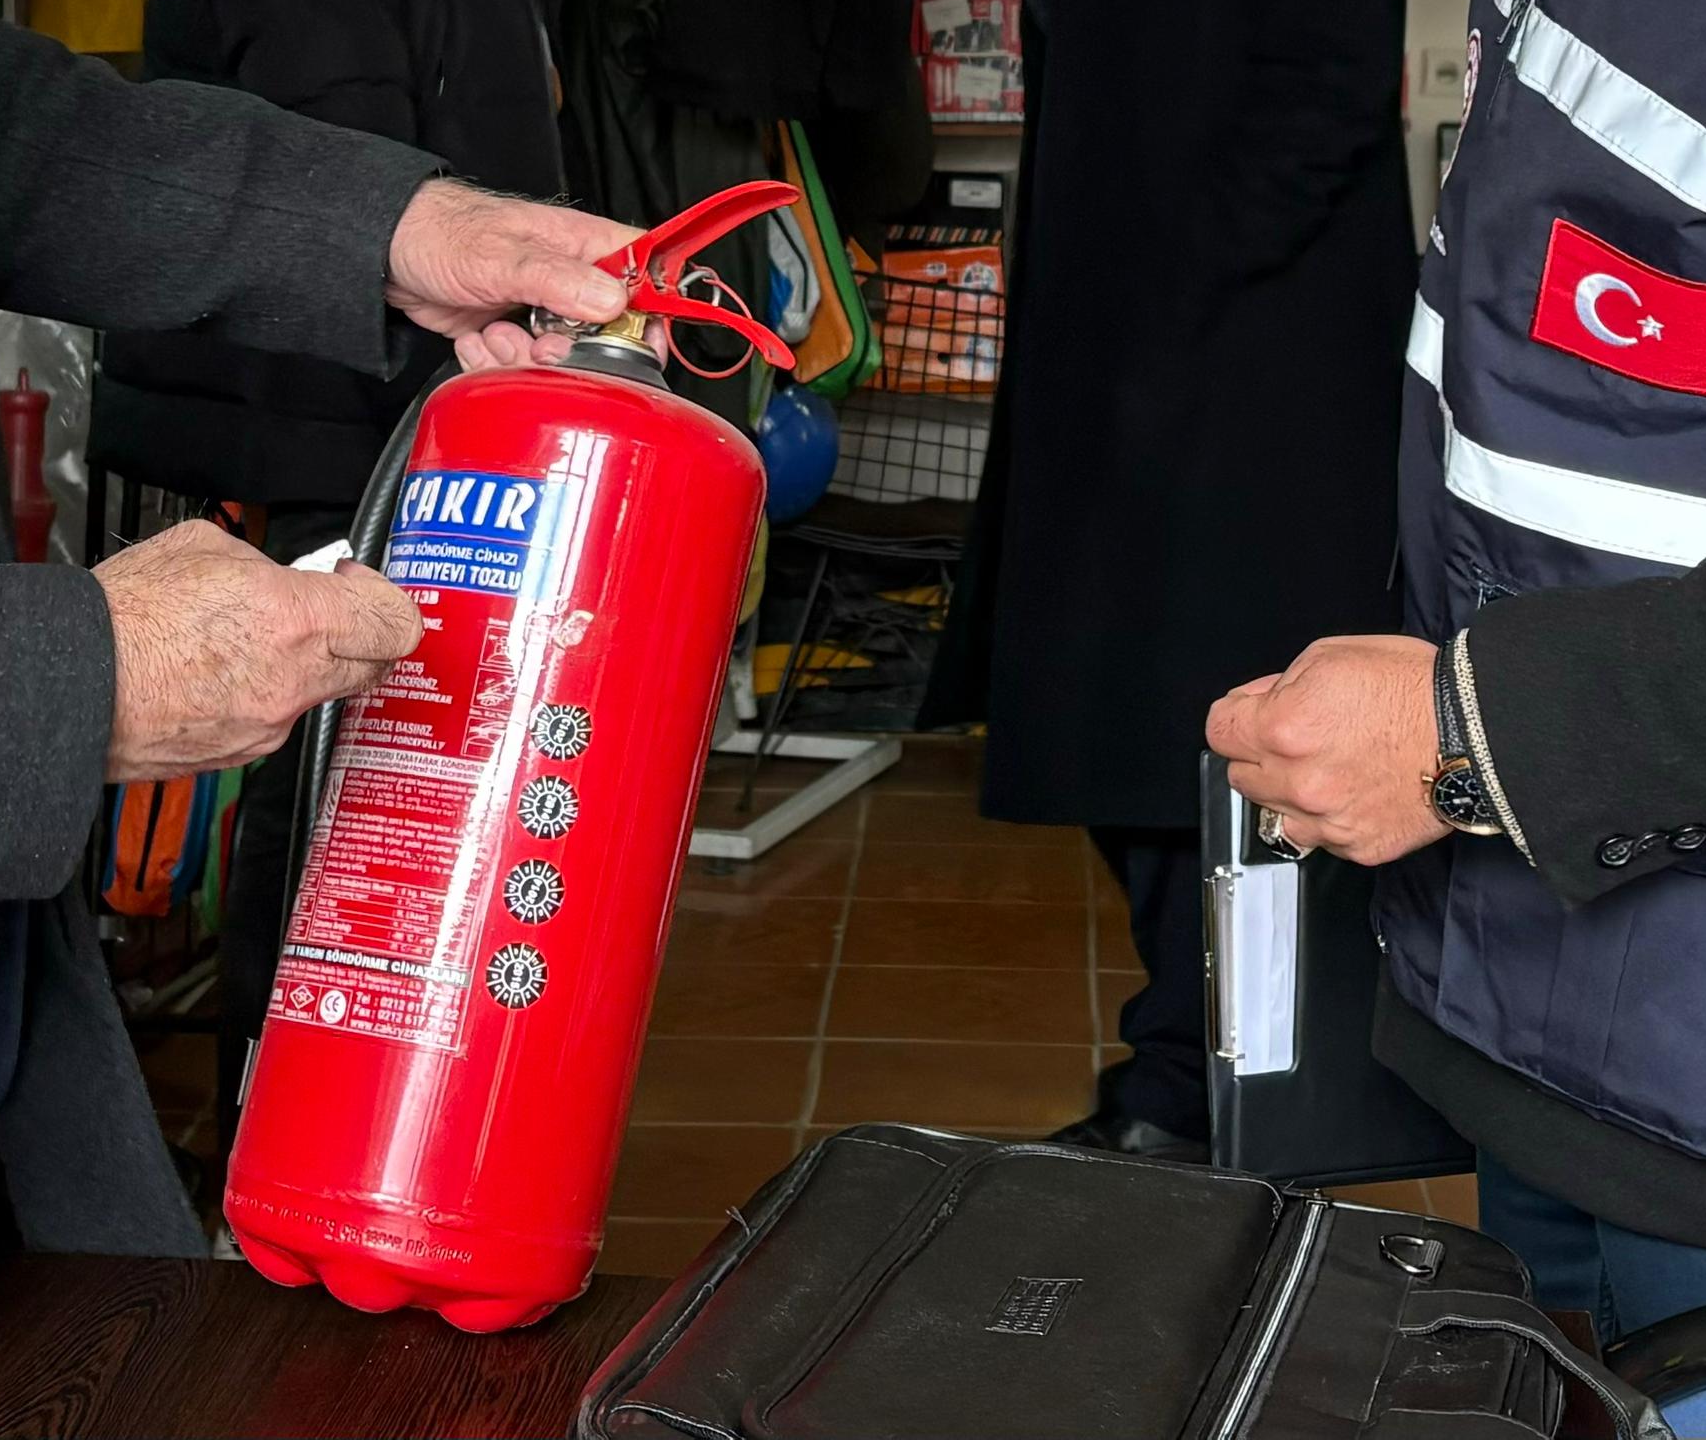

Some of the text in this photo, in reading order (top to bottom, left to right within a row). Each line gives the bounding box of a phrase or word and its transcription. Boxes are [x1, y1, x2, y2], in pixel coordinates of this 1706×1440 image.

[401, 475, 537, 531] ÇAKIR
[414, 540, 474, 561] SÖNDÜRME
[474, 547, 519, 567] CİHAZI
[408, 560, 467, 584] KİMYEVİ
[469, 565, 522, 591] TOZLU
[324, 947, 389, 970] SÖNDÜRME
[390, 960, 467, 985] CİHAZLARI
